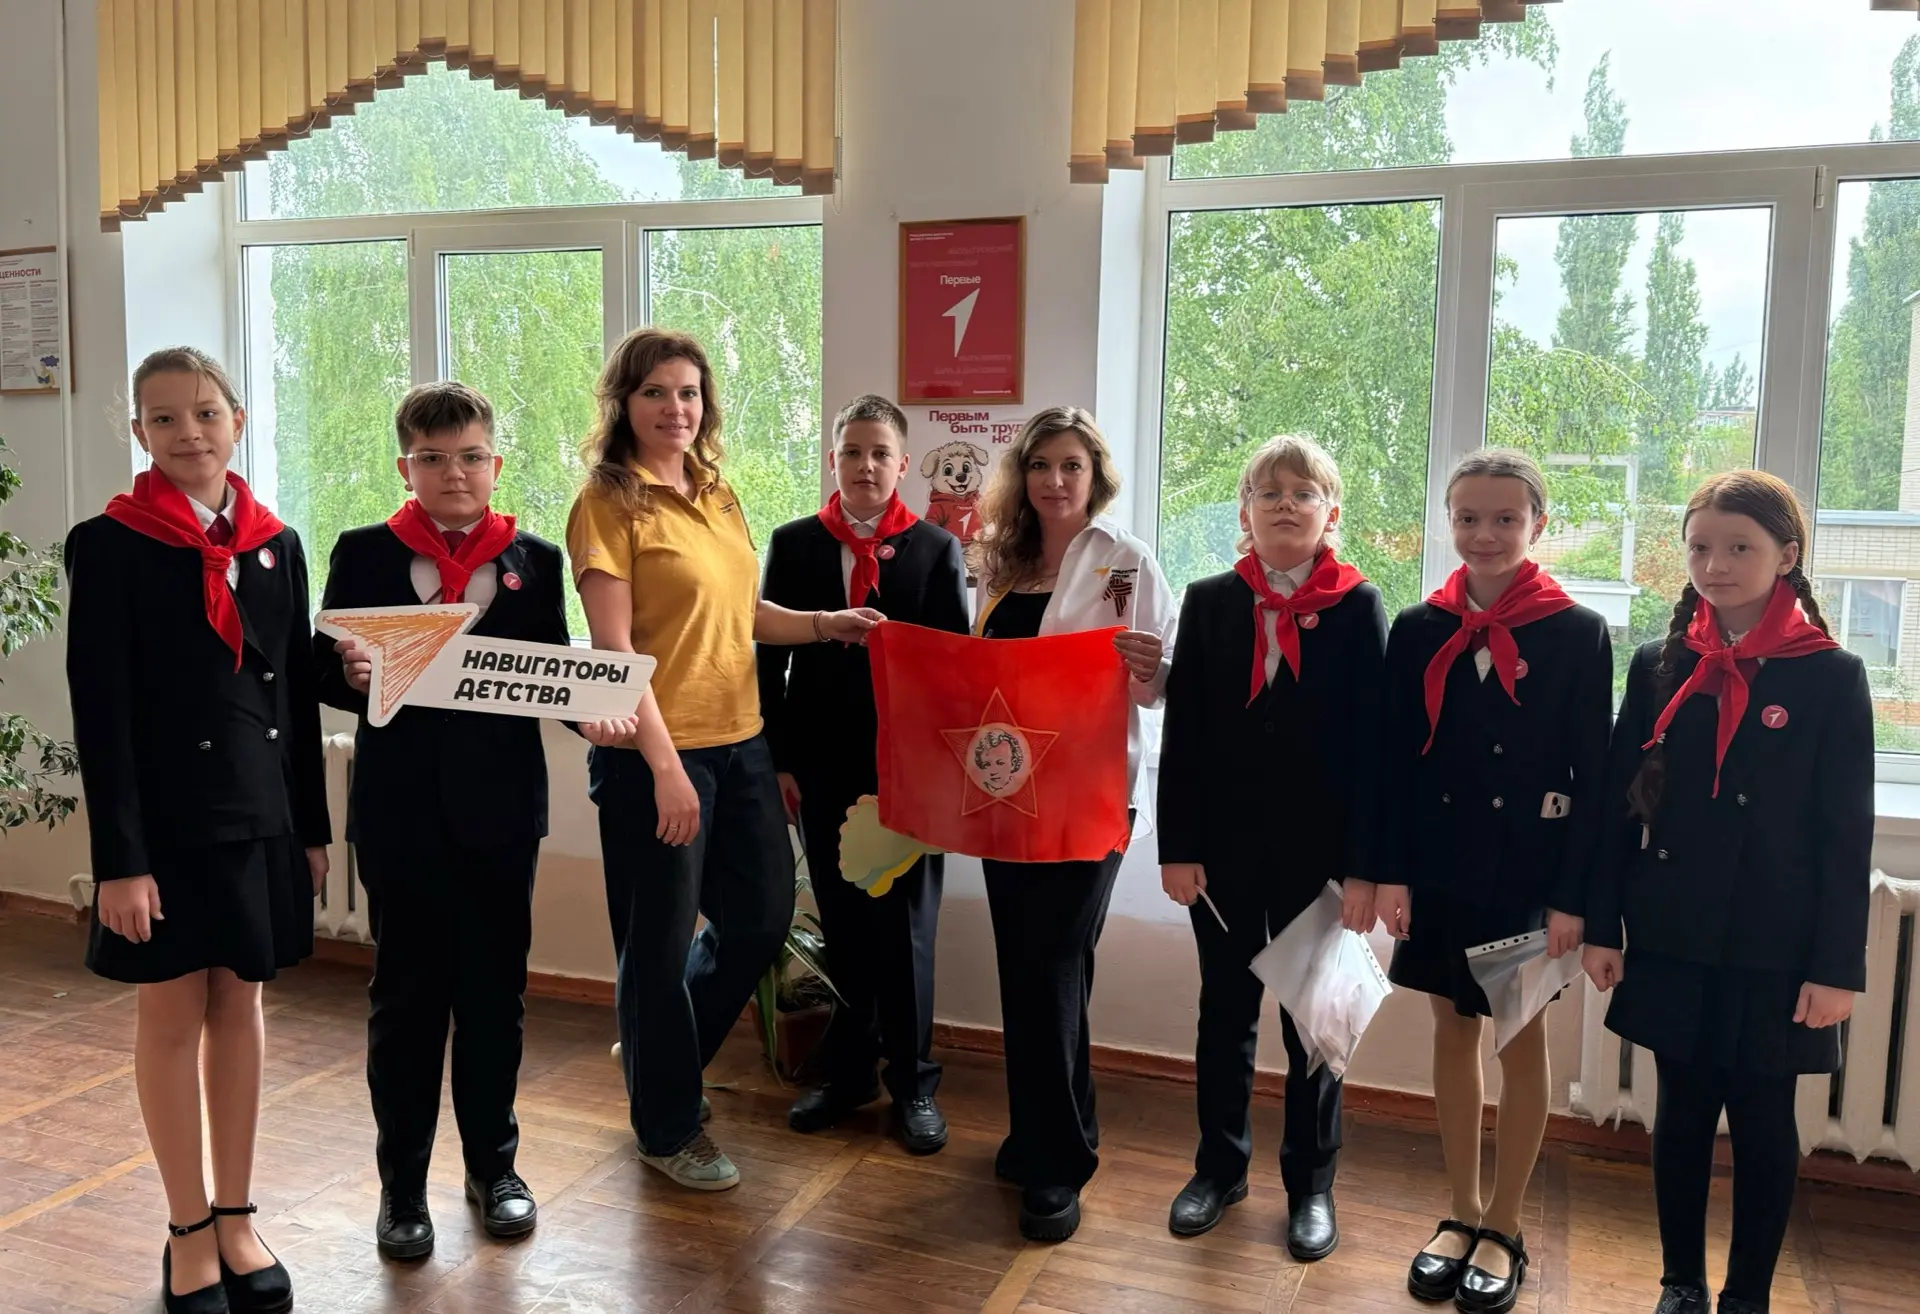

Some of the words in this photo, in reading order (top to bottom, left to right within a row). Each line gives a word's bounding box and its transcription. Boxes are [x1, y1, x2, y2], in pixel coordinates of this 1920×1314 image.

[940, 275, 981, 287] Первые
[929, 410, 989, 424] Первым
[950, 422, 988, 433] быть
[462, 649, 630, 683] НАВИГАТОРЫ
[453, 677, 571, 706] ДЕТСТВА
